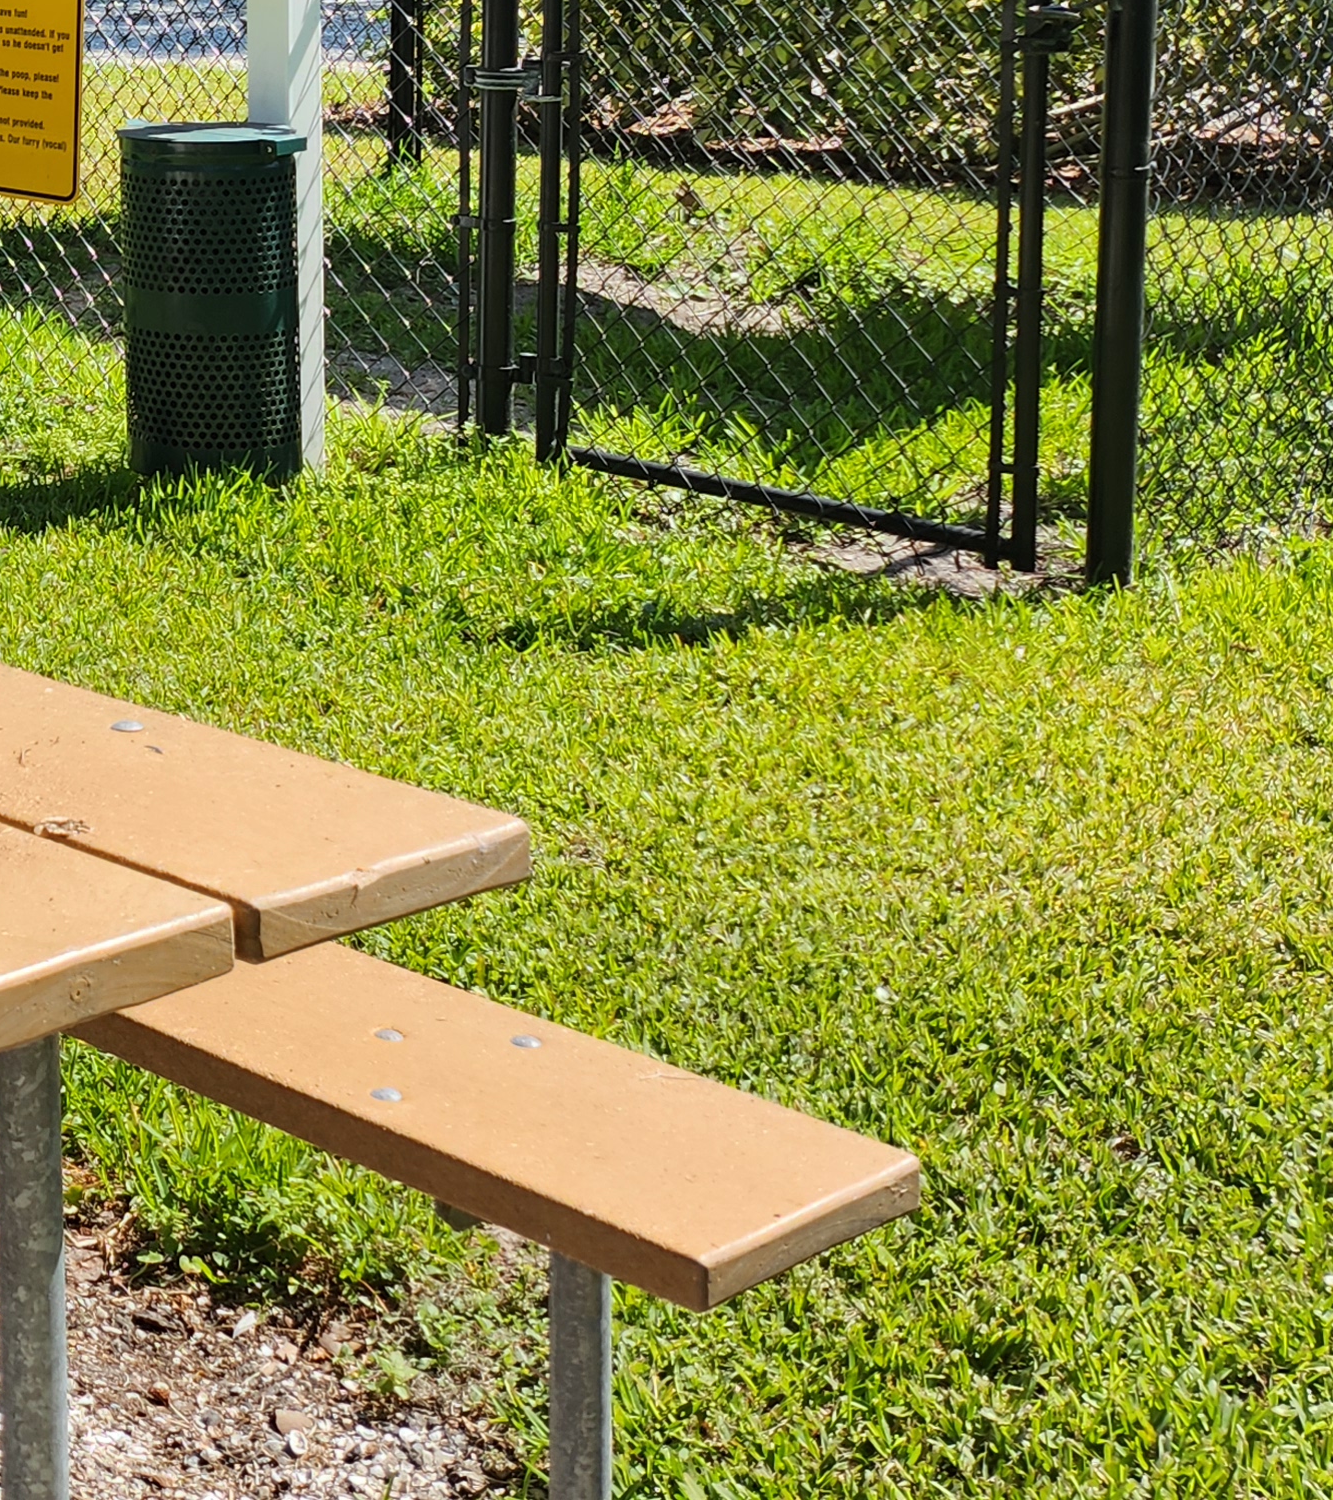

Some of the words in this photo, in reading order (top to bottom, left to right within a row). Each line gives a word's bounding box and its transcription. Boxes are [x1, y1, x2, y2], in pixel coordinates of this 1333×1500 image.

[49, 29, 55, 38] If
[57, 32, 70, 41] you
[2, 39, 10, 47] so
[13, 39, 21, 48] he
[52, 44, 64, 54] get
[22, 88, 39, 100] keep
[41, 90, 52, 100] the
[0, 117, 10, 126] not
[8, 134, 20, 144] Our
[23, 136, 40, 148] furry
[42, 138, 67, 152] (vocal)
